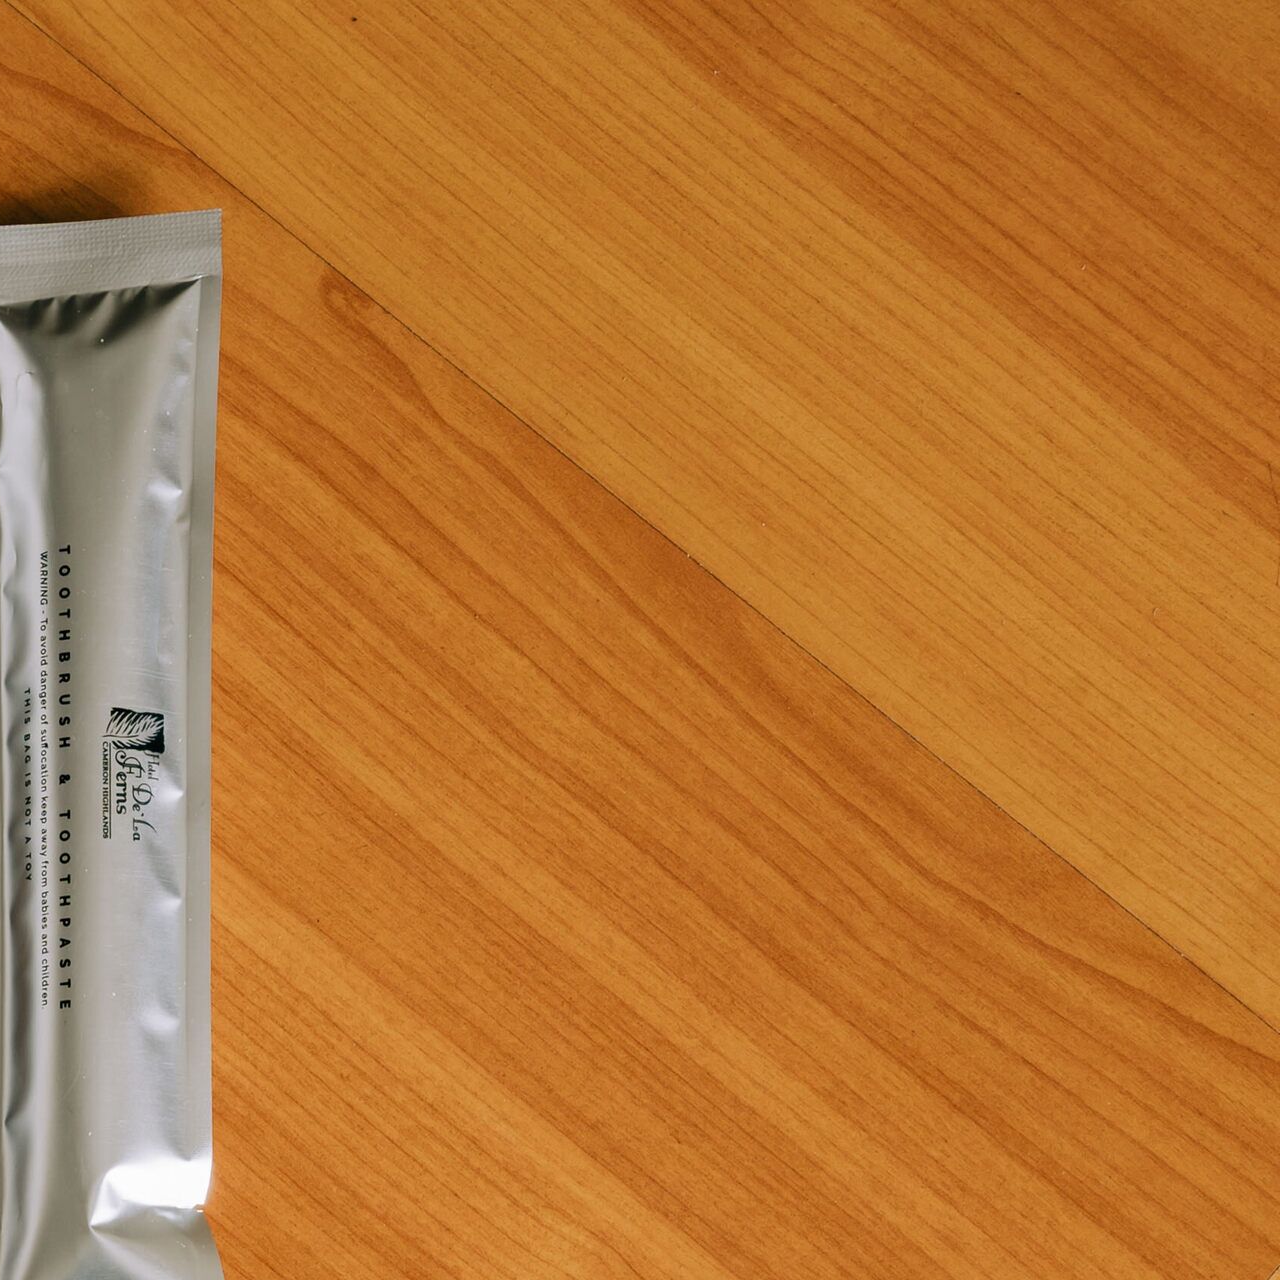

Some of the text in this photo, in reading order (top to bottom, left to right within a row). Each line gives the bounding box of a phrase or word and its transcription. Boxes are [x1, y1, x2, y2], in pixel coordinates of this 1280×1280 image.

[38, 551, 49, 1009] WARNING To avoid danger of suffocation keep away from babies and children.
[58, 545, 71, 1010] TOOTHBRUSH & TOOTHPASTE
[115, 750, 146, 815] Ferns
[143, 750, 160, 781] Hotel
